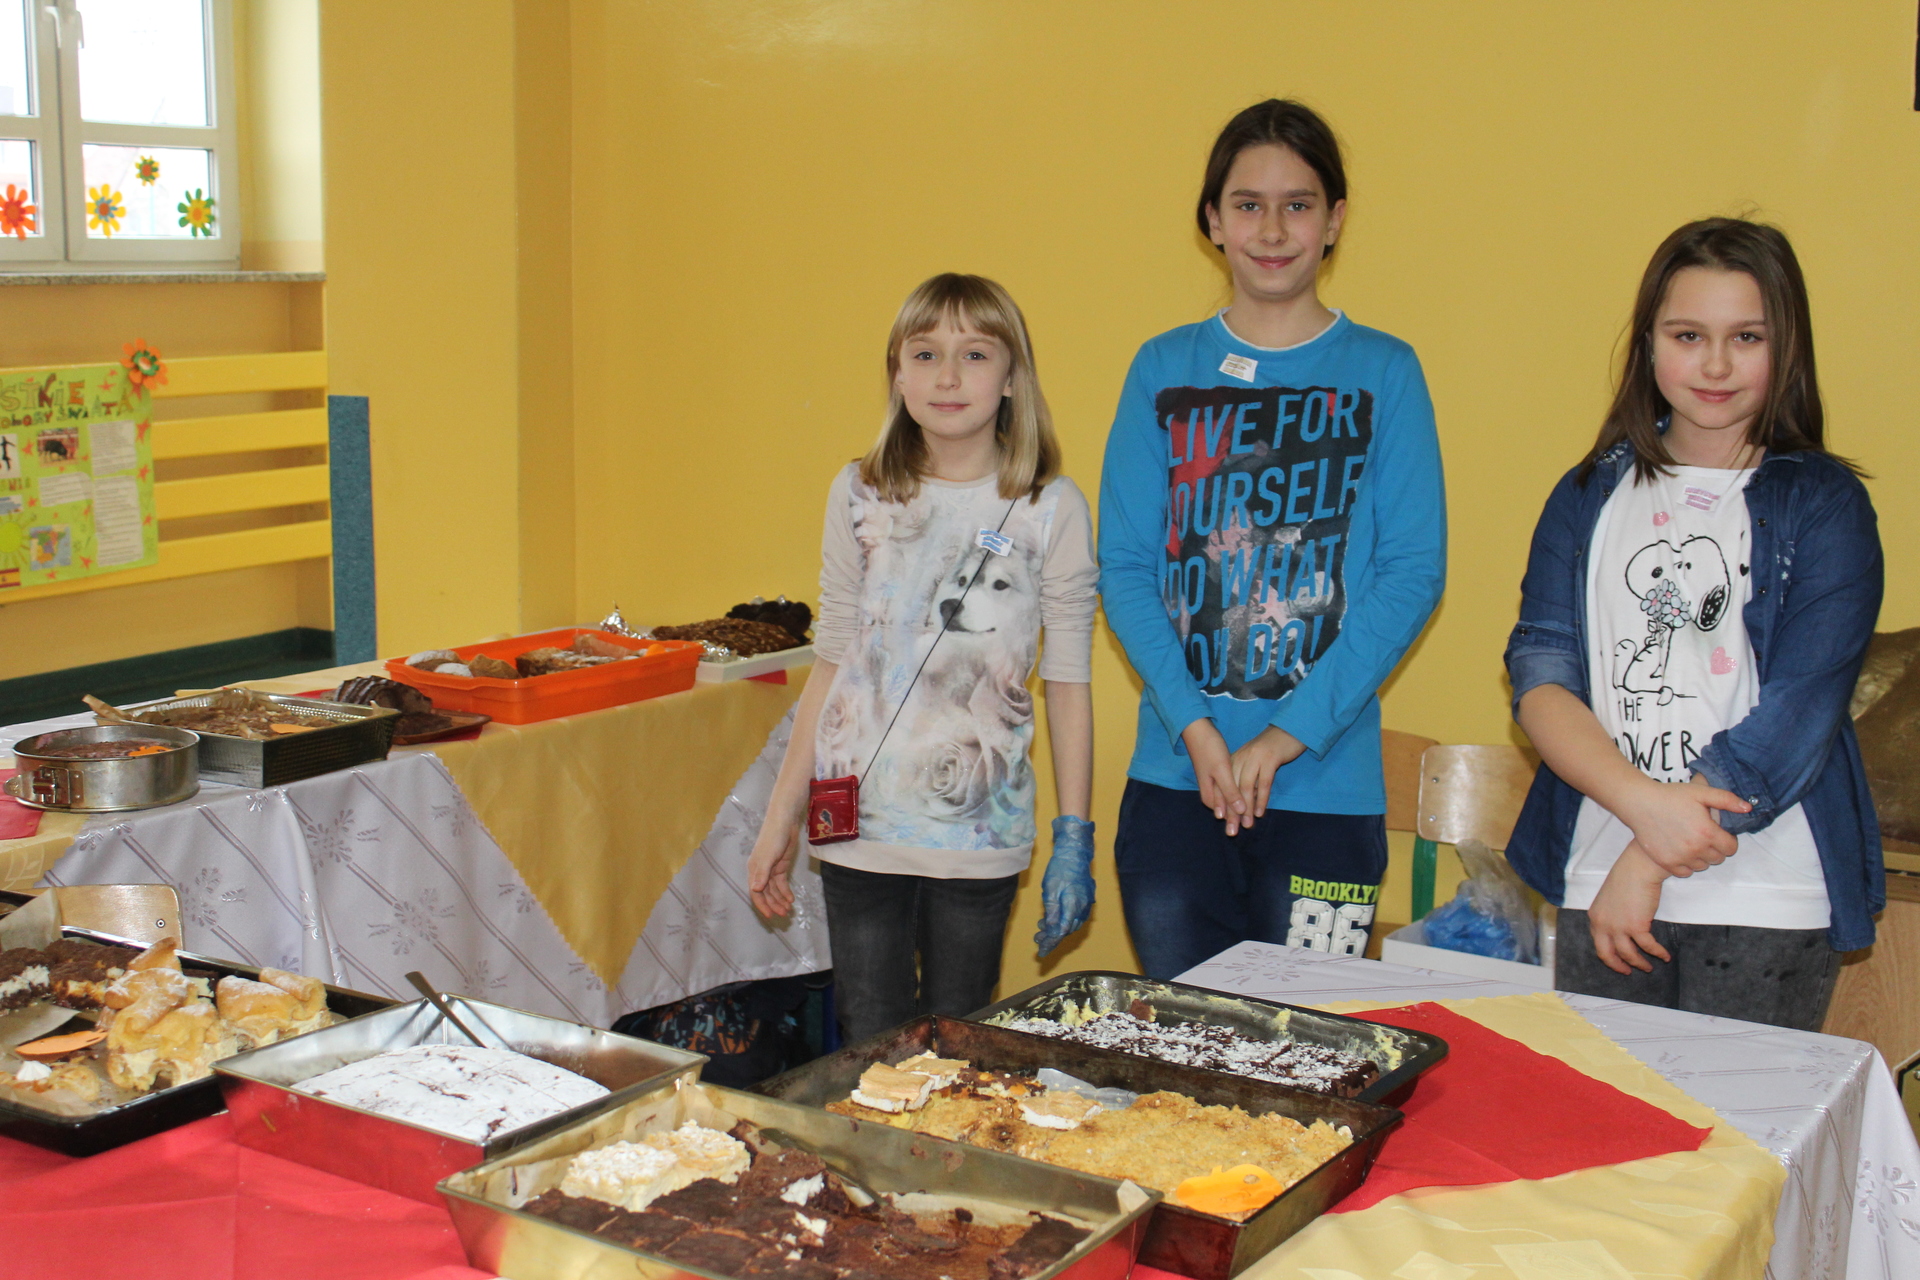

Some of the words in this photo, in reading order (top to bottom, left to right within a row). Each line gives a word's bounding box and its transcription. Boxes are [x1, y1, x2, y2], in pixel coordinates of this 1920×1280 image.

[1166, 401, 1263, 469] LIVE
[1273, 387, 1360, 450] FOR
[1167, 555, 1206, 619] DO
[1221, 533, 1341, 609] WHAT
[1184, 627, 1230, 688] OU
[1617, 696, 1644, 722] HE
[1614, 730, 1701, 772] OWER
[1286, 898, 1376, 958] 86
